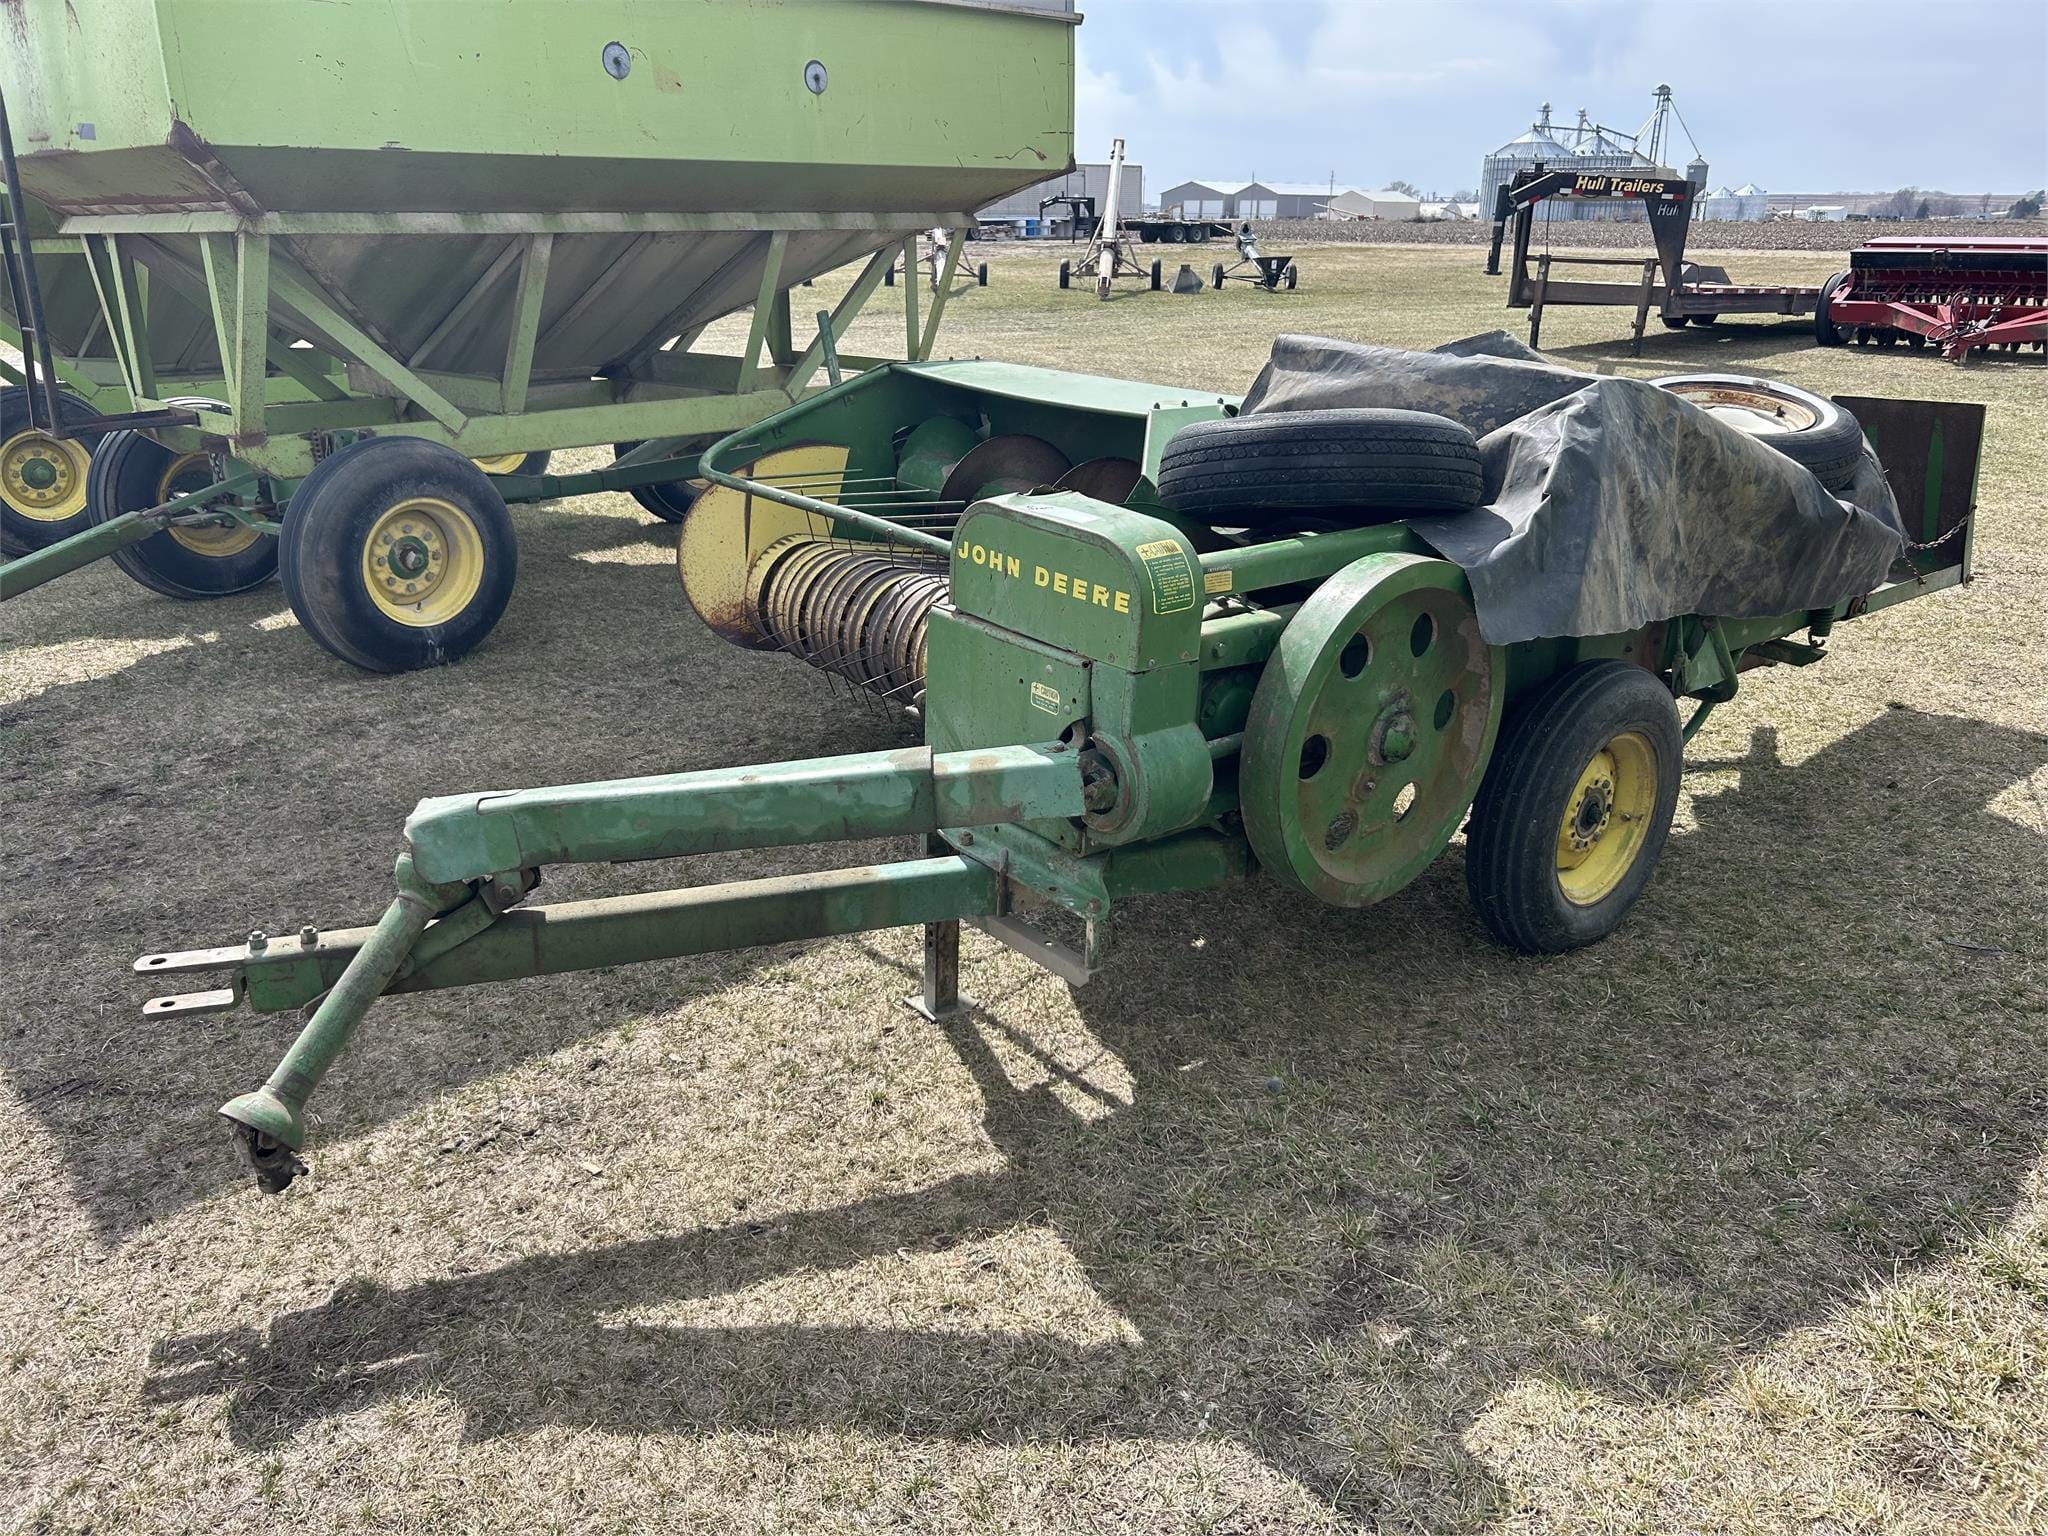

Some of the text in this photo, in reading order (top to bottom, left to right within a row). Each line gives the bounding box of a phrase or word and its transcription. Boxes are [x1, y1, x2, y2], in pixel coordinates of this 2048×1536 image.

[1575, 175, 1665, 193] Hull Trailers
[958, 541, 1021, 578] JOHN
[1034, 565, 1131, 614] DEERE
